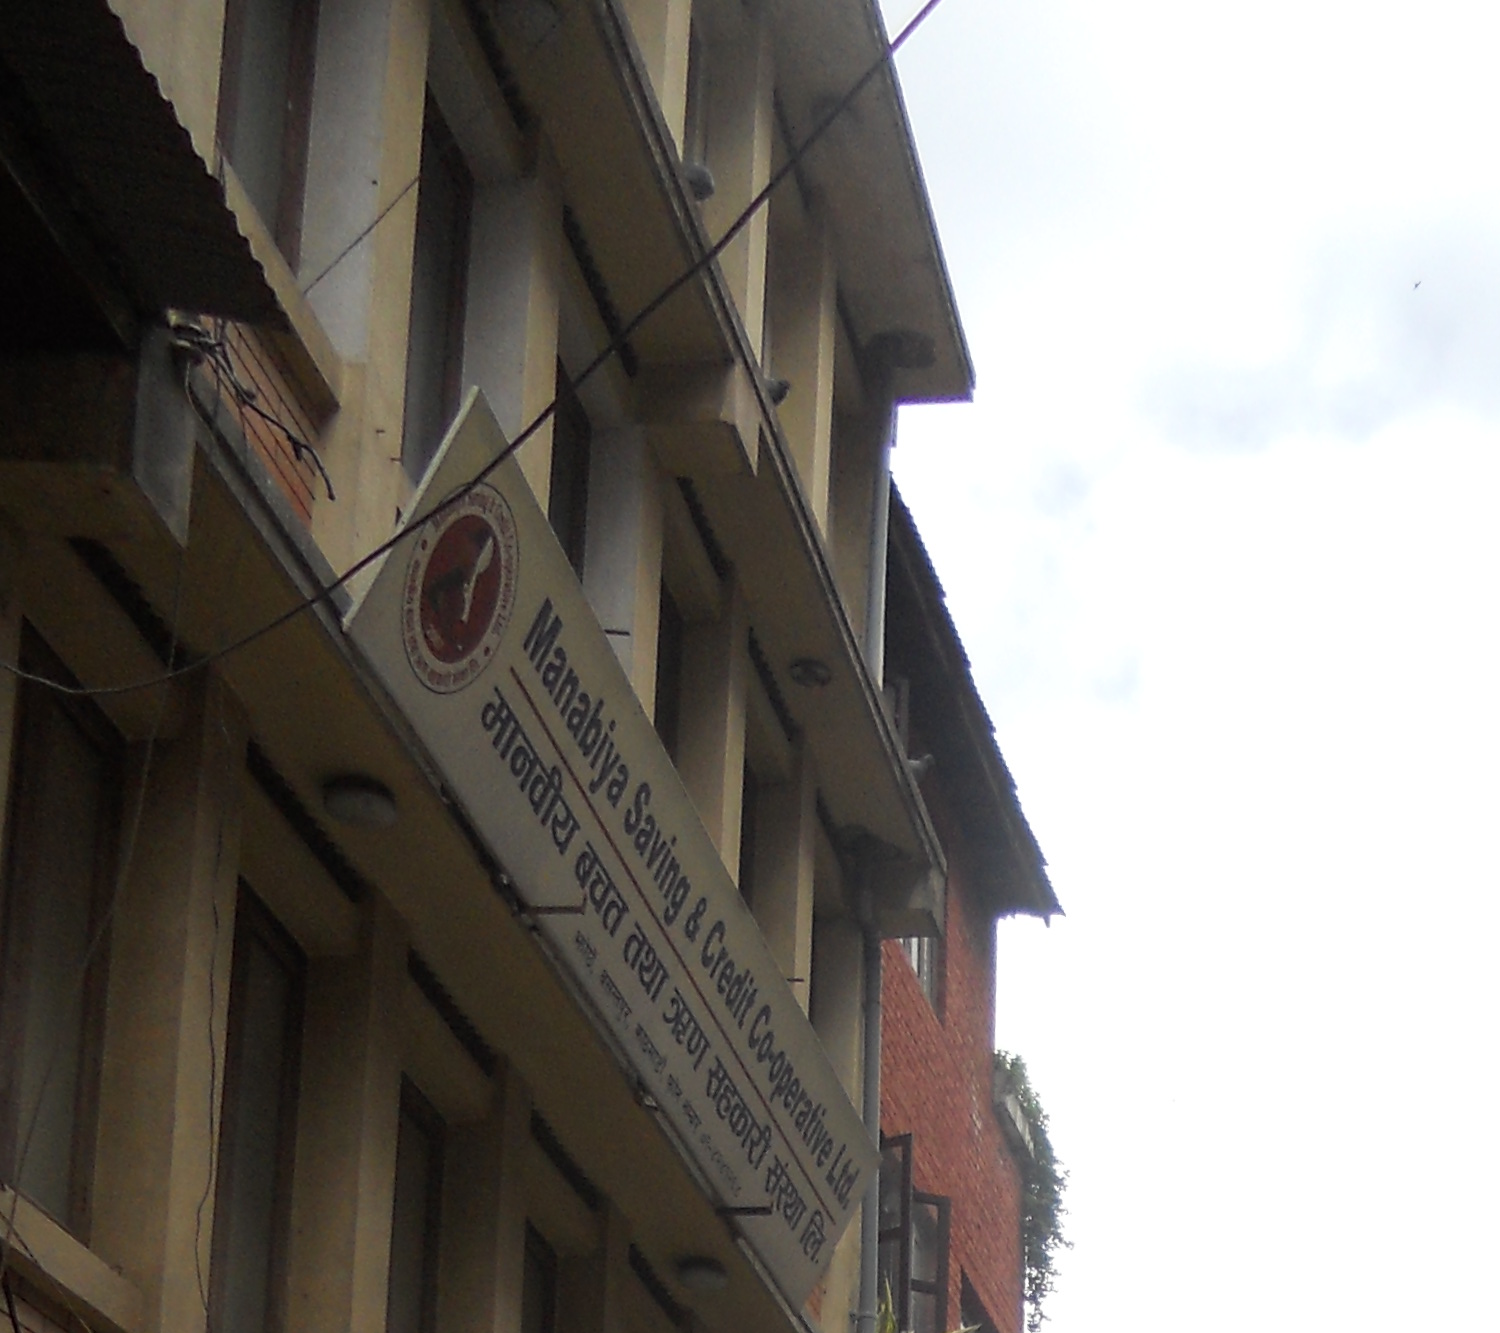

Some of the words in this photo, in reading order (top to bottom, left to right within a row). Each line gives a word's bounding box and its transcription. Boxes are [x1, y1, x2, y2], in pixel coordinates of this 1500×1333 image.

[523, 597, 630, 808] Manabiya
[623, 781, 692, 928] Saving
[684, 897, 708, 943] &
[700, 919, 760, 1030] Credit
[748, 1003, 836, 1169] Co-operative
[574, 840, 630, 938] बचत
[623, 921, 670, 1003] तथा
[706, 1055, 773, 1171] सहकारी
